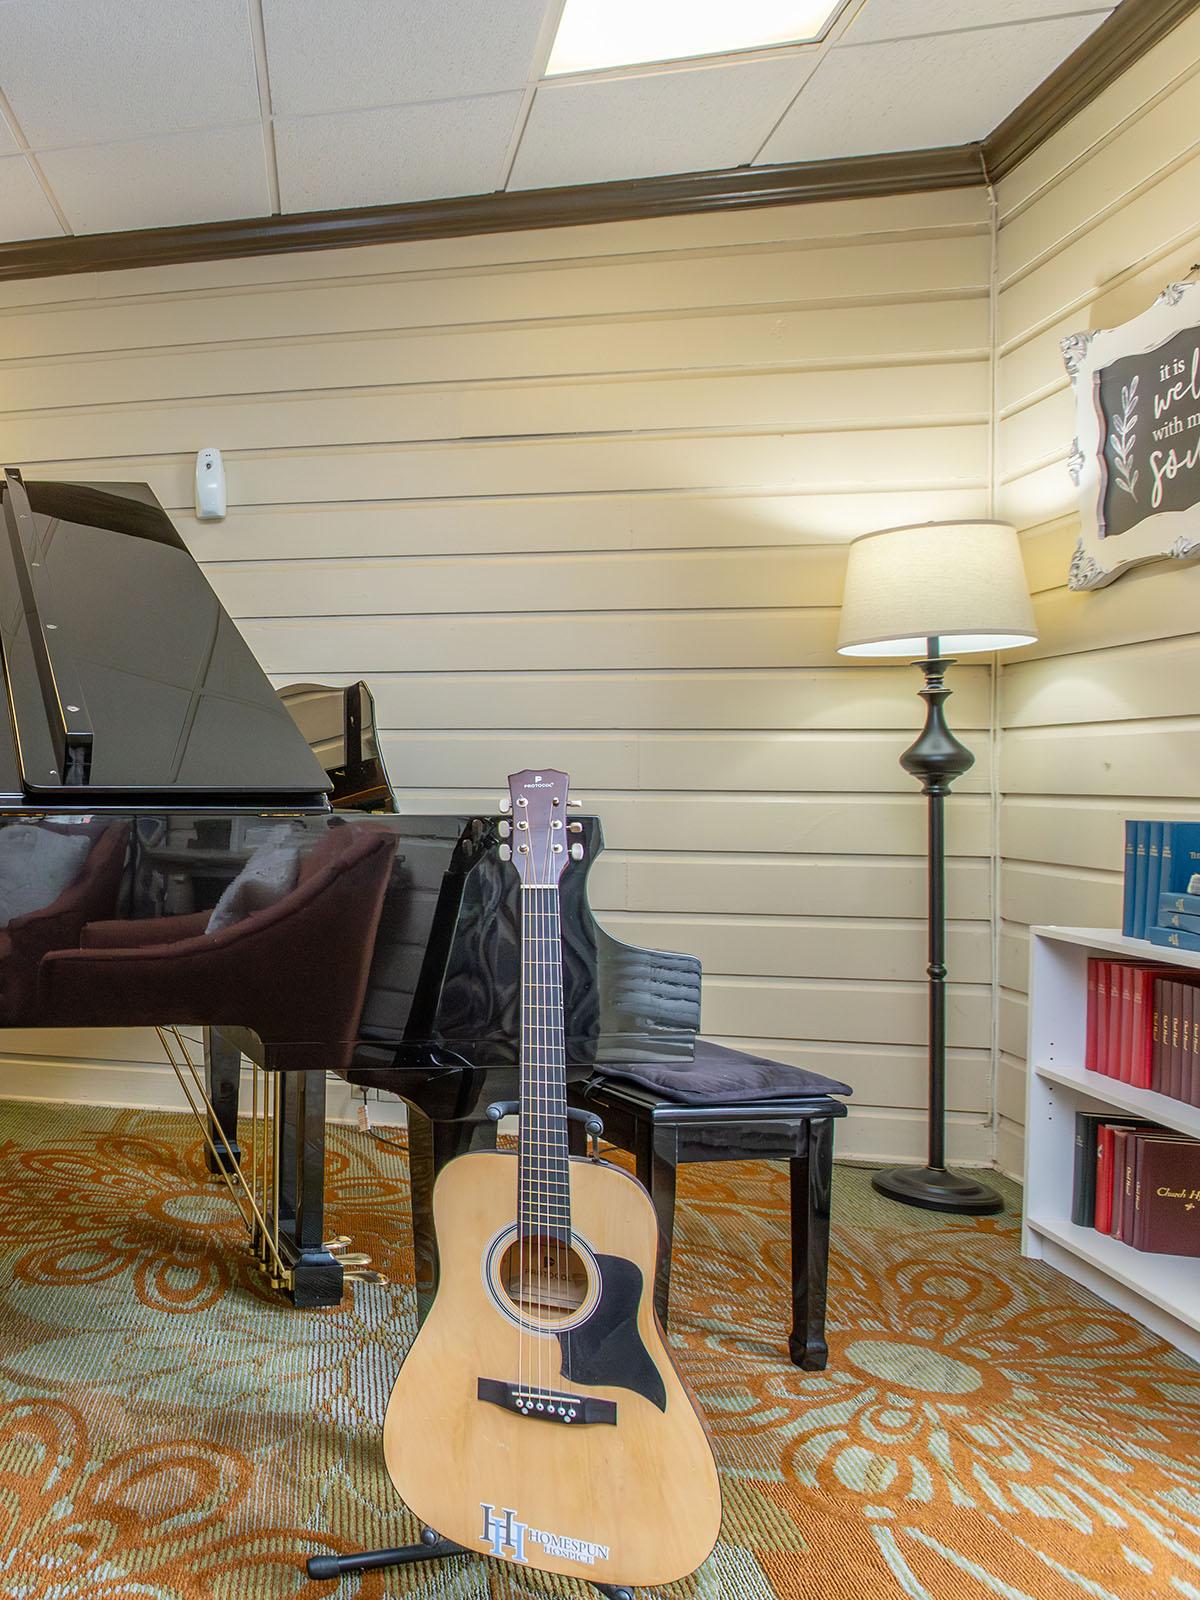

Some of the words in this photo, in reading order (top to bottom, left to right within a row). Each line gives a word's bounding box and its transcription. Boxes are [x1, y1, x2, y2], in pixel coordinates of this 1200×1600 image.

[1159, 364, 1171, 382] it
[1173, 358, 1186, 376] is
[1152, 415, 1184, 442] with
[1156, 1186, 1187, 1199] Church
[529, 1529, 609, 1561] HOMESPUN
[543, 1545, 595, 1565] HOSPICE
